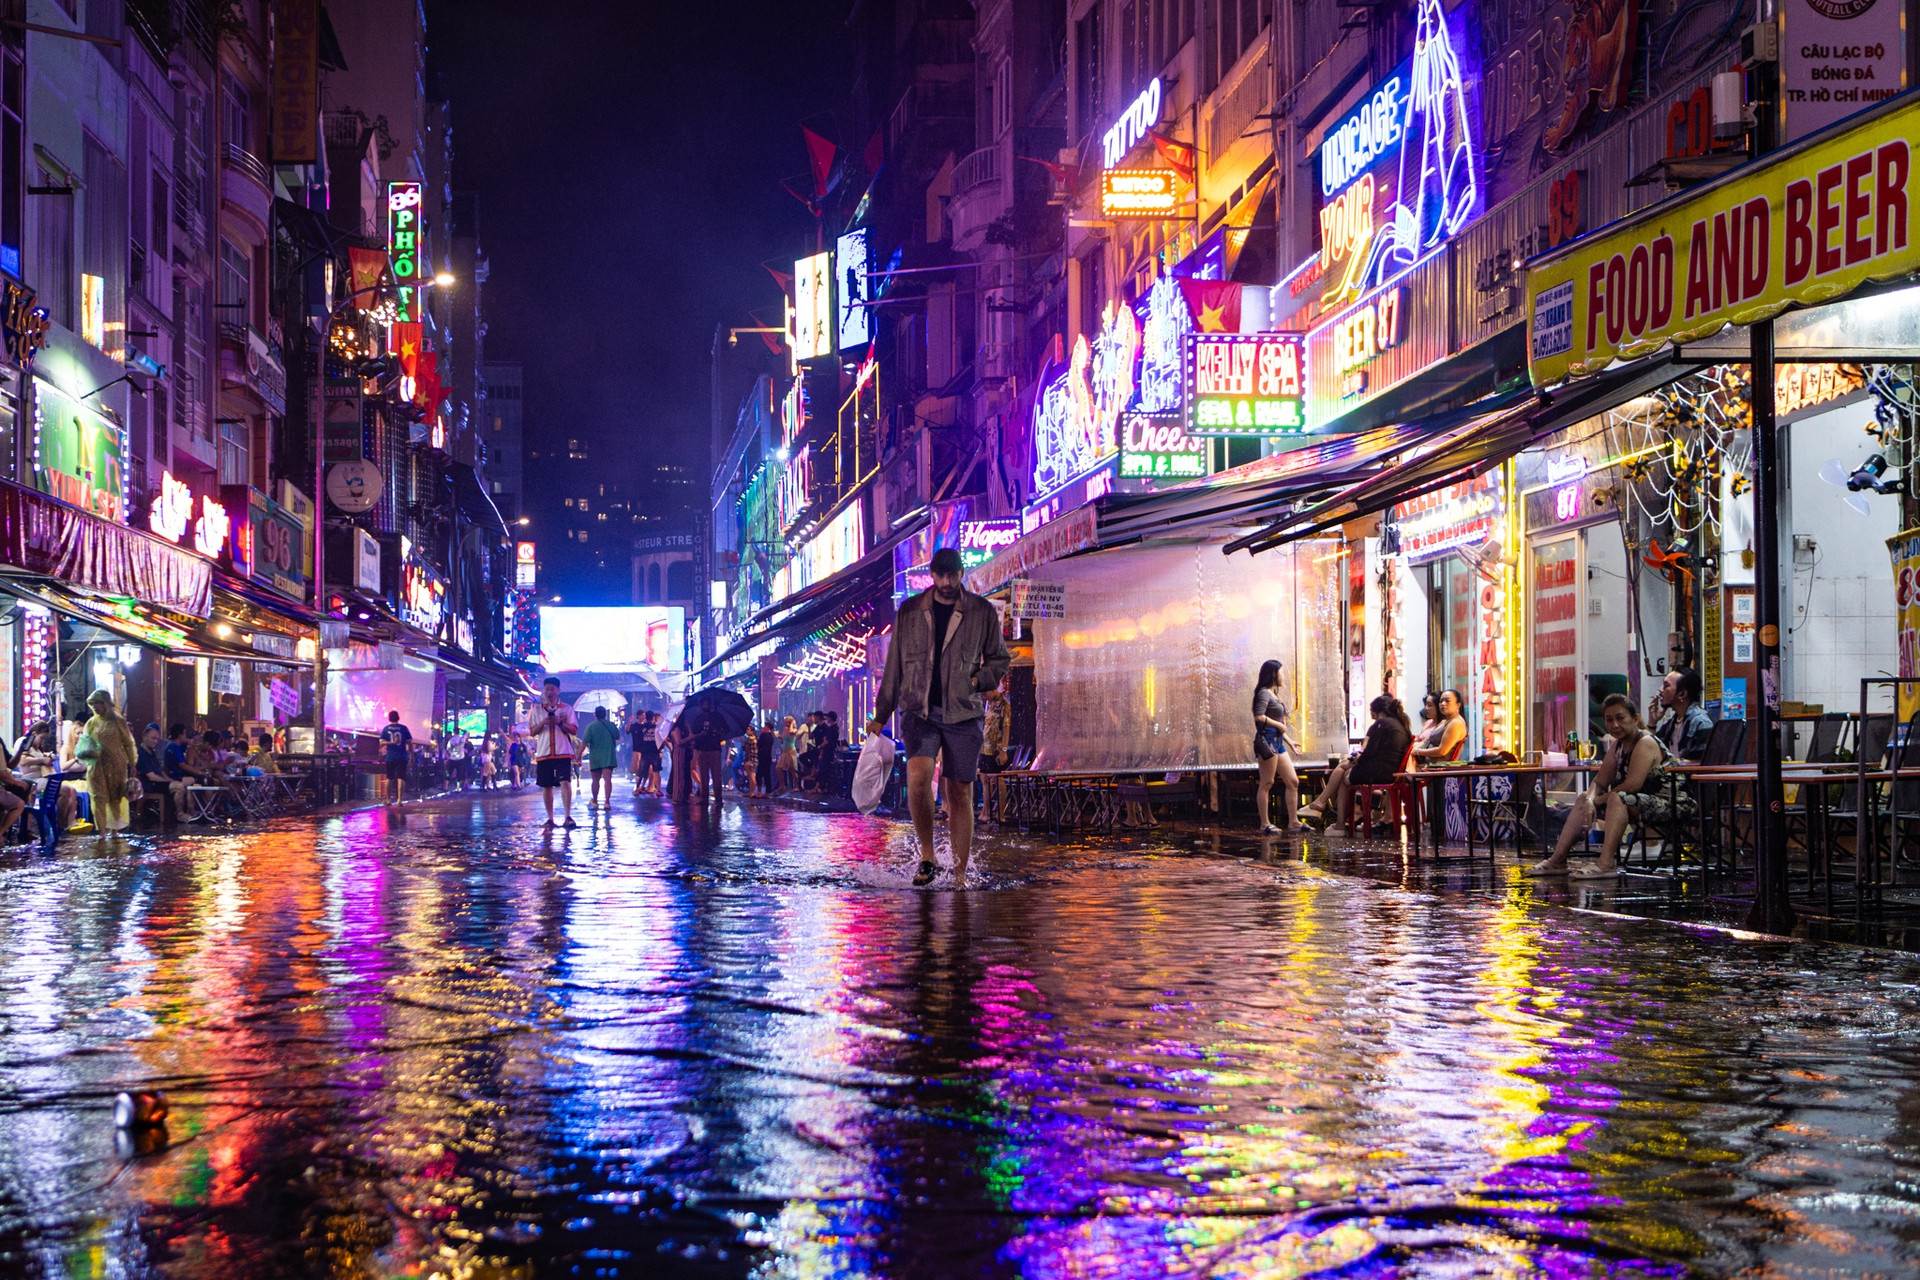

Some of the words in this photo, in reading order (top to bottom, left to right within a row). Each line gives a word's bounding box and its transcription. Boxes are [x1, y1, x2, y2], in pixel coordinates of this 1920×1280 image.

[1801, 43, 1830, 59] CÂU
[1833, 46, 1861, 61] LẠC
[1864, 42, 1885, 60] BỘ
[1811, 64, 1851, 80] BÓNG
[1854, 64, 1875, 80] ĐÁ
[1810, 86, 1831, 102] HỒ
[1834, 86, 1859, 102] CHÍ
[1103, 77, 1160, 169] TATTOO
[1322, 76, 1401, 196] UNCAGE
[389, 188, 420, 210] 86
[1319, 172, 1374, 269] YOUR
[1550, 170, 1579, 247] 89
[1586, 235, 1674, 351] FOOD
[1683, 196, 1770, 321] AND
[1783, 138, 1911, 288] BEER
[1334, 304, 1376, 376] BEER
[1377, 287, 1400, 350] 87
[1197, 342, 1257, 394] KELLY
[1258, 342, 1299, 395] SPA
[1126, 415, 1200, 452] Cheers
[1197, 400, 1234, 425] SPA
[1557, 486, 1577, 520] 87
[265, 518, 291, 572] 96
